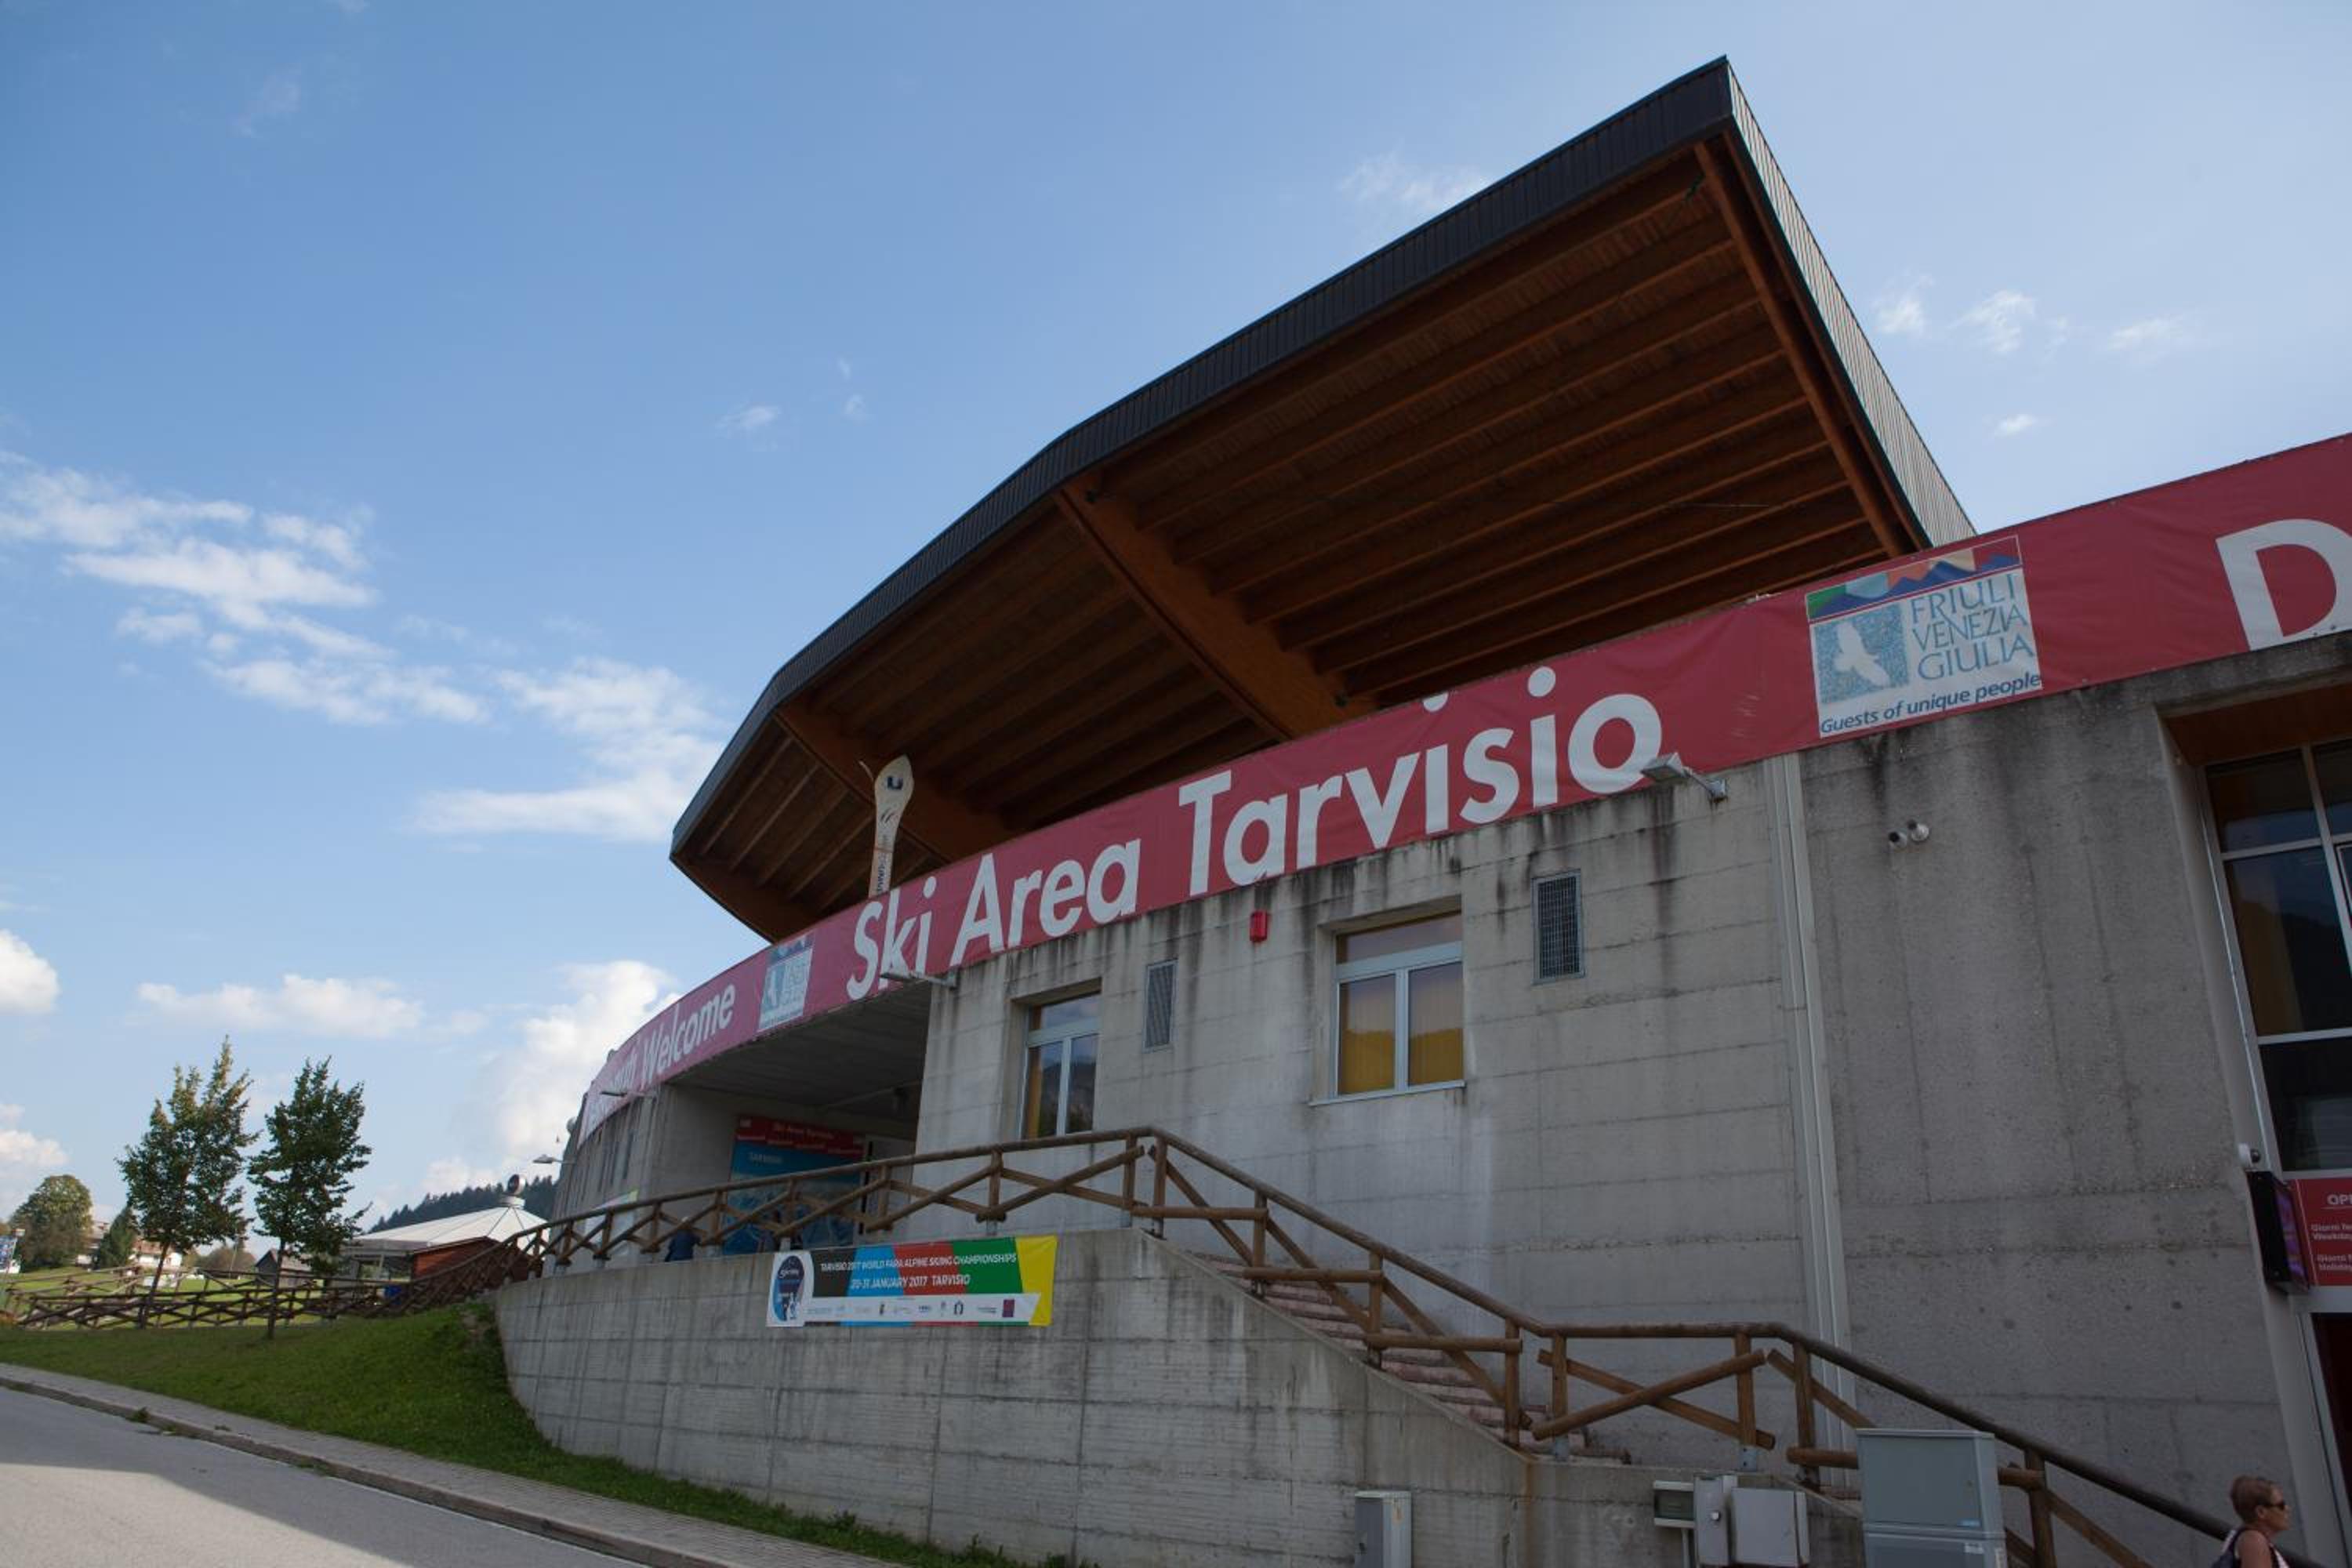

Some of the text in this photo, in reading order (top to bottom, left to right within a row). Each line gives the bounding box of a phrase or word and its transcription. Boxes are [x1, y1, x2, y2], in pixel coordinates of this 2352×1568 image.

[1911, 573, 2020, 624] FRIULI
[1912, 604, 2028, 652] VENEZIA
[1918, 633, 2034, 681] GIULIA
[1820, 672, 2041, 734] Guests of unique people
[846, 666, 1663, 1001] Ski Area Tarvisio
[641, 984, 735, 1086] Welcome
[870, 1276, 908, 1290] JANUARY
[931, 1273, 971, 1287] TARVISIO
